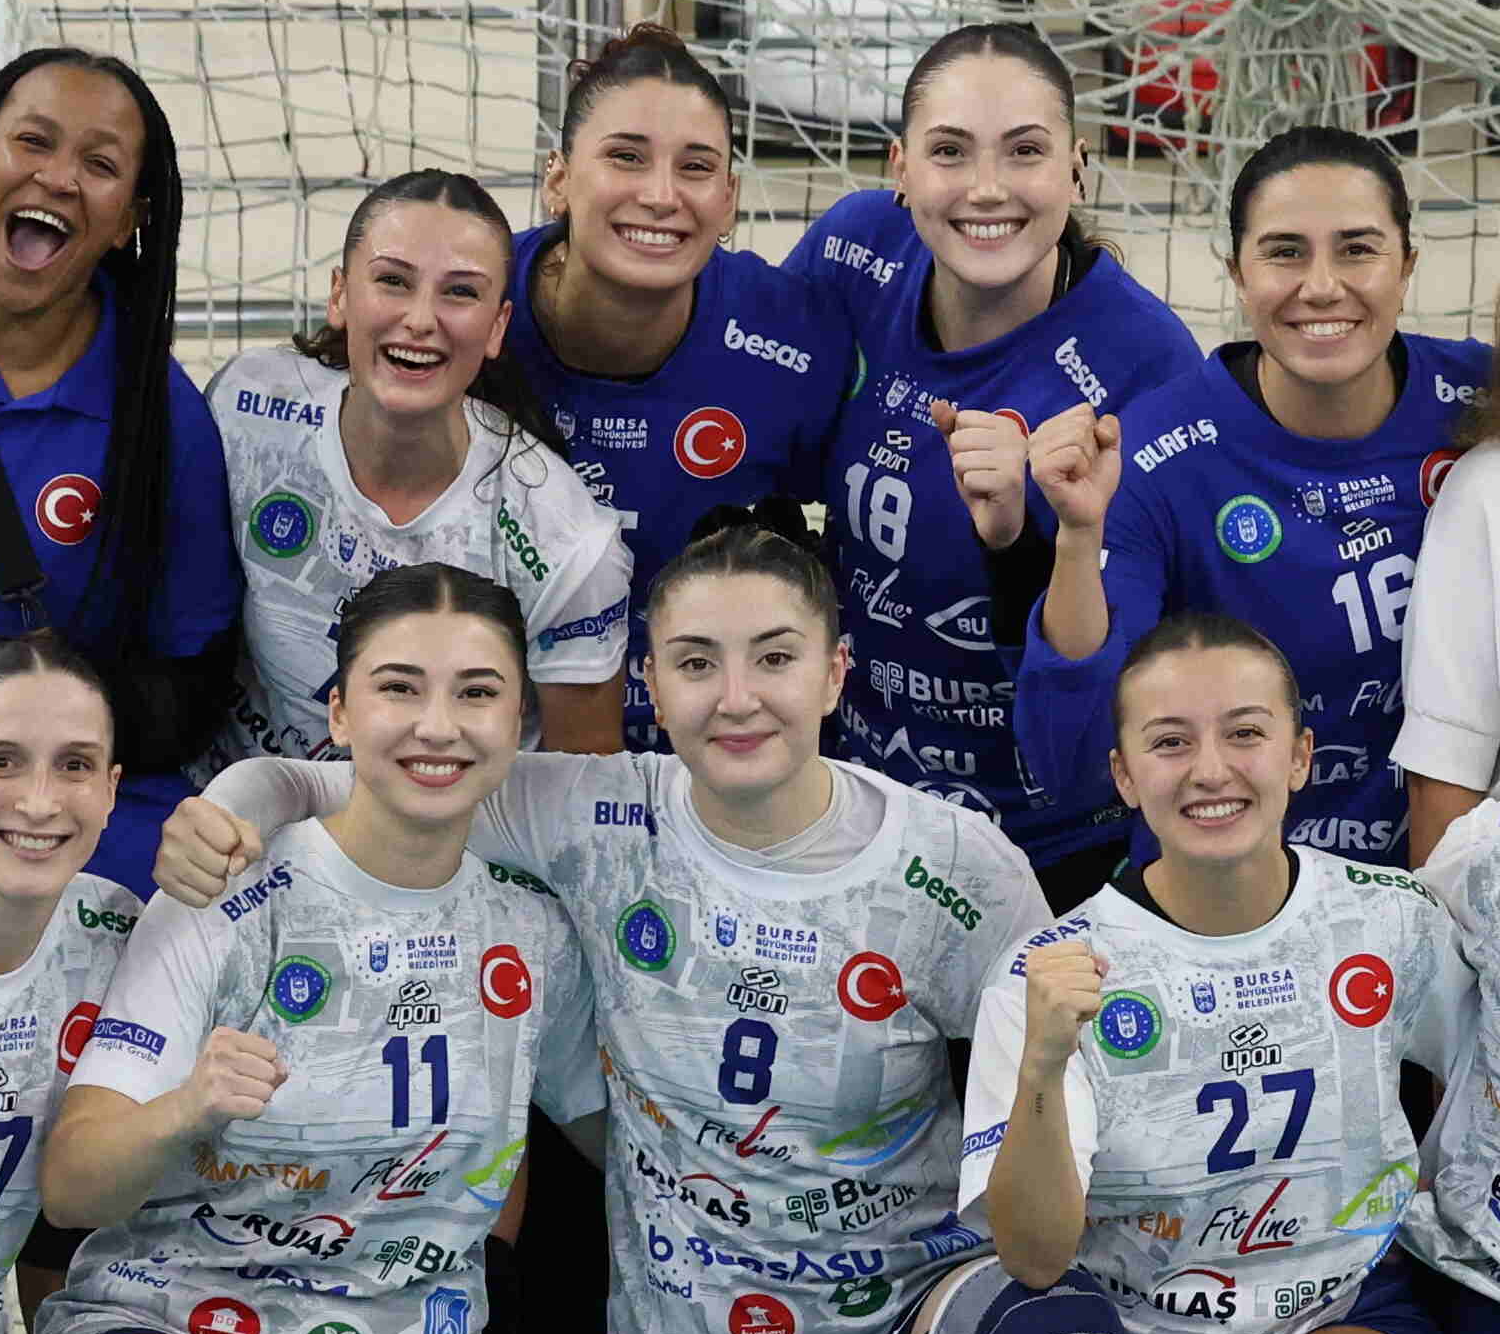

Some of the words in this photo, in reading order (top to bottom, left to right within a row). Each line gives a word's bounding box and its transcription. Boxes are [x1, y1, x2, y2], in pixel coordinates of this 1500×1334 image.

[723, 318, 812, 374] besas
[1054, 337, 1107, 406] besas
[592, 418, 648, 430] BURSA
[868, 442, 911, 472] upon
[1133, 418, 1219, 472] BURFAŞ
[1338, 474, 1391, 494] BURSA
[844, 462, 914, 562] 18
[1338, 525, 1393, 562] upon
[1331, 553, 1417, 654] 16
[908, 669, 1016, 704] BURS
[904, 856, 982, 931] besas
[406, 935, 458, 951] BURSA
[756, 924, 818, 943] BURSA
[1234, 969, 1295, 988] BURSA
[387, 1003, 441, 1030] upon
[727, 984, 789, 1015] upon
[1237, 992, 1298, 1010] BELEDİYESİ
[717, 1017, 778, 1105] 8
[1221, 1042, 1283, 1075] upon
[381, 1034, 450, 1129] 11
[1196, 1068, 1317, 1174] 27
[351, 1130, 449, 1201] FitLine
[1198, 1177, 1302, 1255] FitLine
